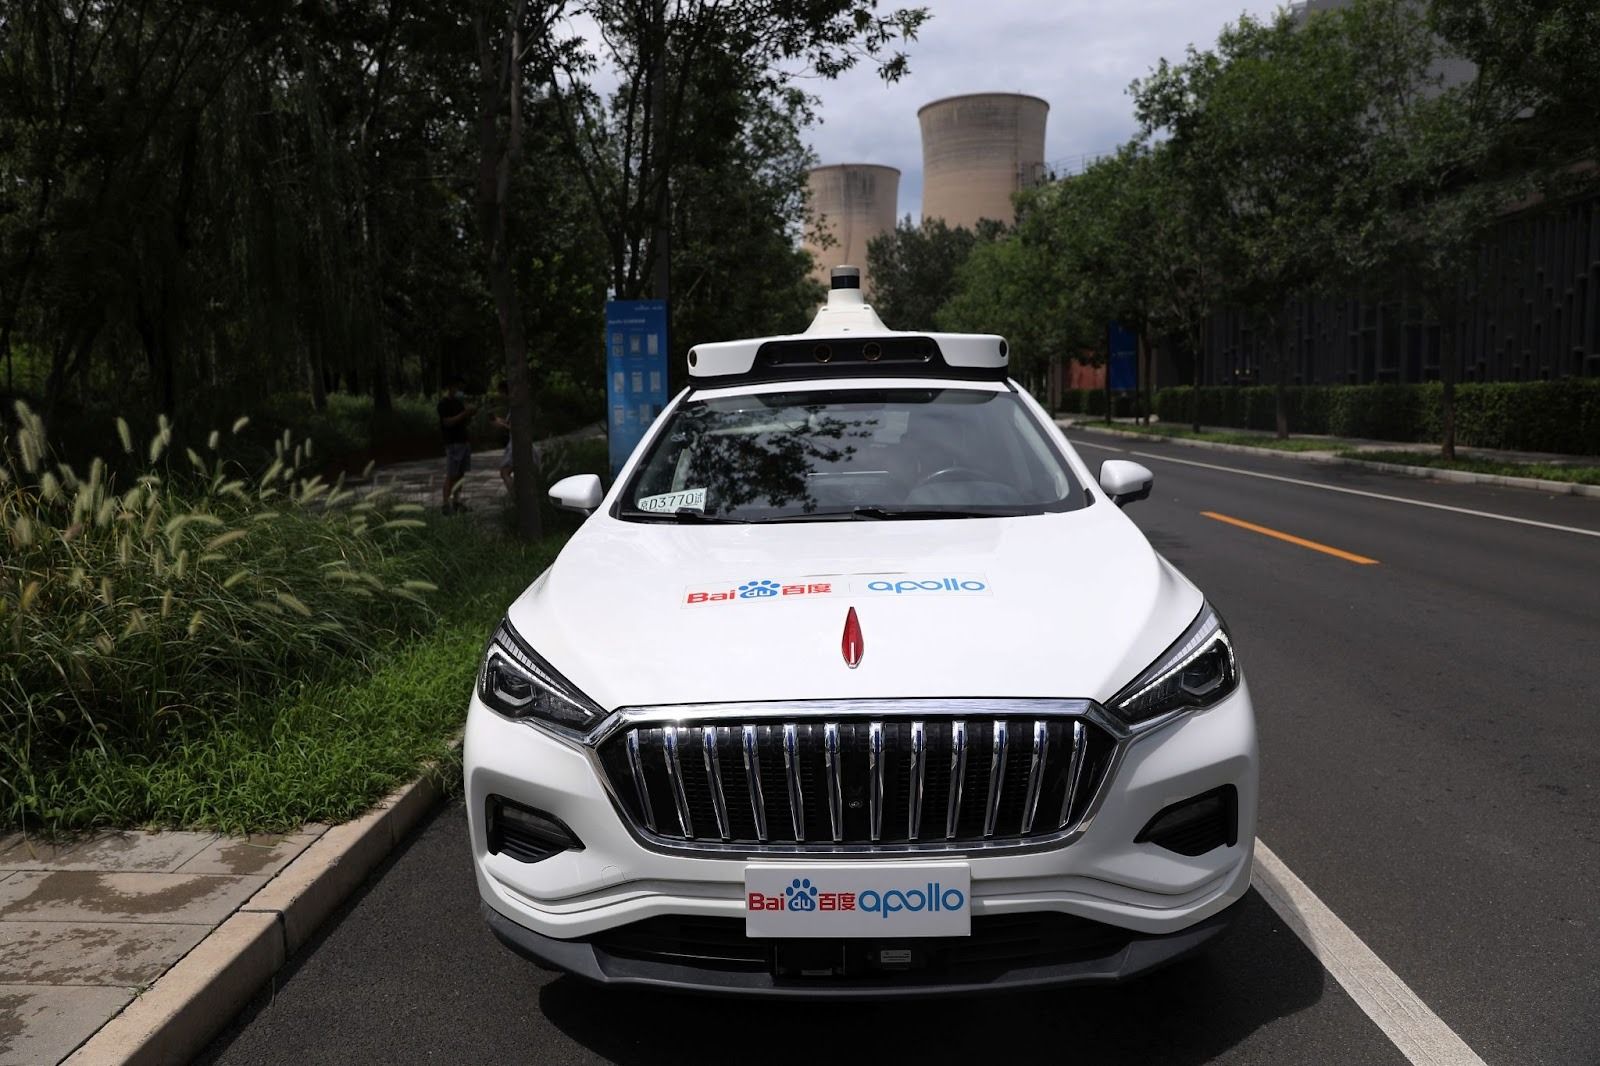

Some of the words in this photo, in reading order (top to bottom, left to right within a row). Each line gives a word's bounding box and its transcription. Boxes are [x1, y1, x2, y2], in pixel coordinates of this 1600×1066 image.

[782, 583, 832, 596] 百度
[868, 578, 985, 594] apollo
[818, 892, 856, 911] 百度
[858, 882, 965, 918] apollo
